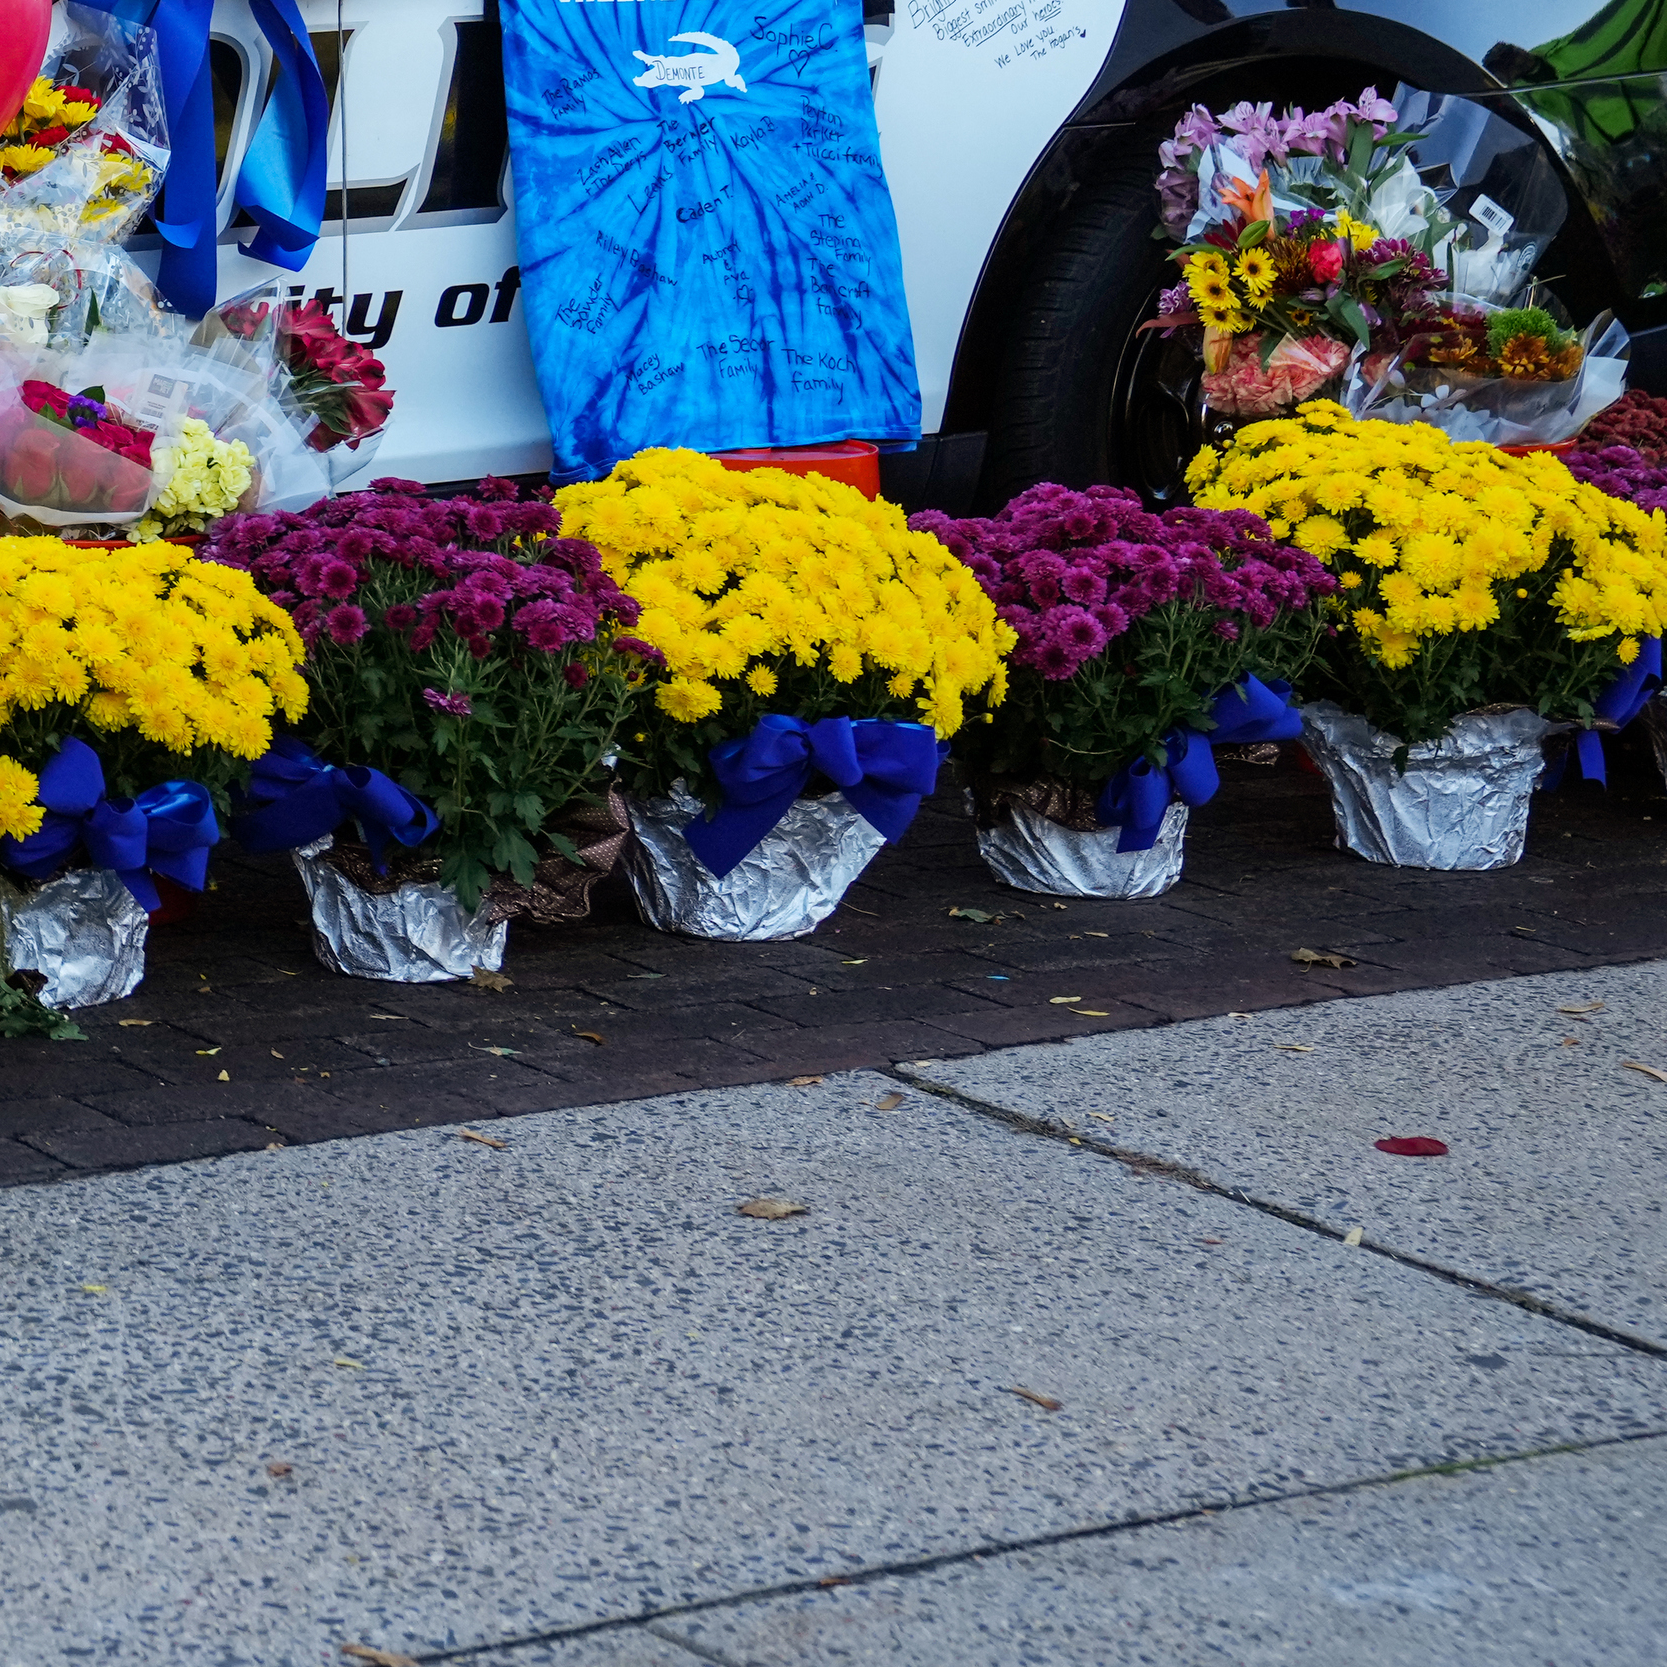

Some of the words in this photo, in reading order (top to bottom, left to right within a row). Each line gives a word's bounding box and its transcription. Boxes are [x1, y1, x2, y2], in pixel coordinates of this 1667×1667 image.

[750, 16, 815, 48] Sophie
[932, 8, 973, 41] Biggest
[962, 1, 1026, 48] Extraordinary
[1010, 18, 1029, 34] Our
[994, 54, 1011, 69] We
[1014, 41, 1034, 56] Love
[1030, 48, 1047, 61] The
[653, 60, 706, 81] DEMONTE
[800, 95, 843, 126] Peyton
[657, 119, 679, 136] The
[678, 136, 720, 168] Family
[675, 193, 724, 224] Caden
[818, 213, 846, 230] The
[595, 230, 629, 261] Riley
[807, 257, 835, 278] The
[835, 247, 872, 276] Family
[433, 265, 521, 329] of
[696, 340, 728, 361] The
[781, 349, 814, 366] The
[818, 353, 857, 373] Koch
[719, 359, 759, 387] Family
[791, 370, 845, 405] family
